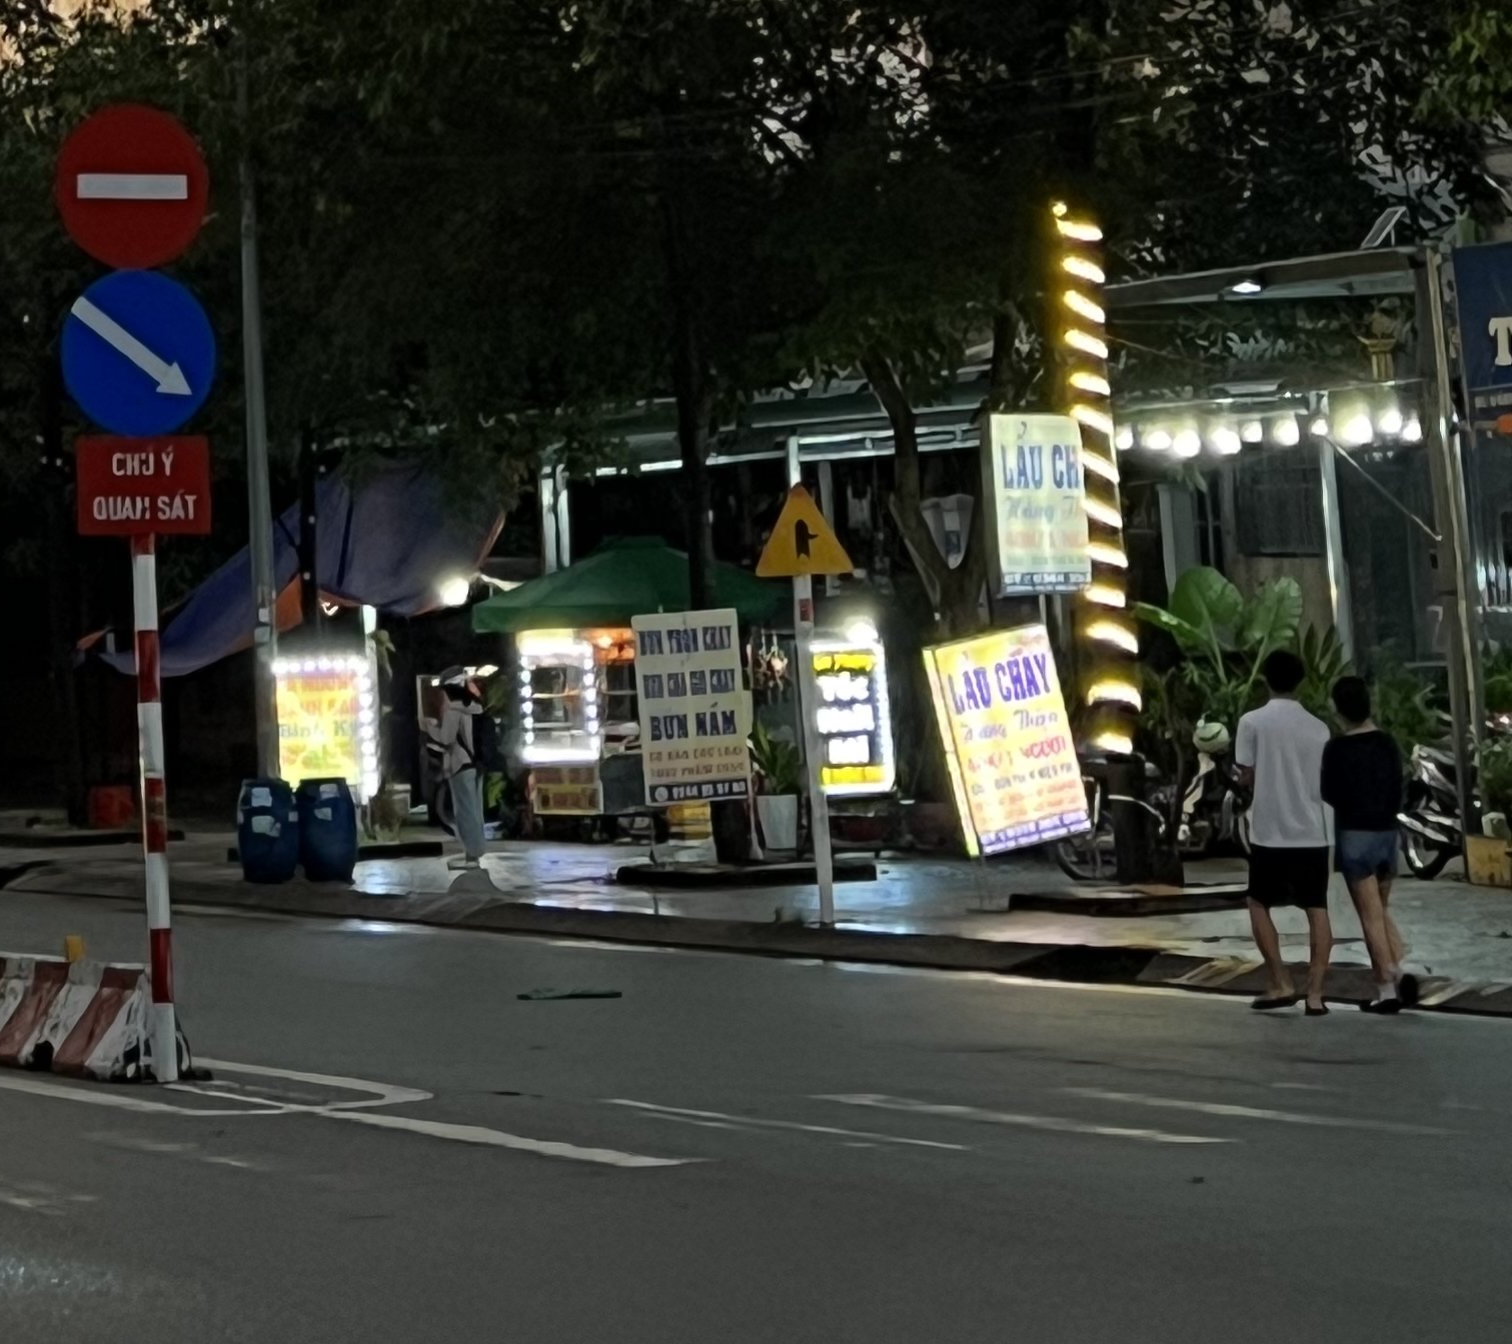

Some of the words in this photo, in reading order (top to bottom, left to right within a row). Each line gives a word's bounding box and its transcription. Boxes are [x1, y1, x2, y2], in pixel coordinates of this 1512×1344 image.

[161, 444, 175, 477] Ý
[1050, 443, 1081, 490] CH
[92, 495, 151, 521] QUAN
[156, 488, 198, 521] SÁT
